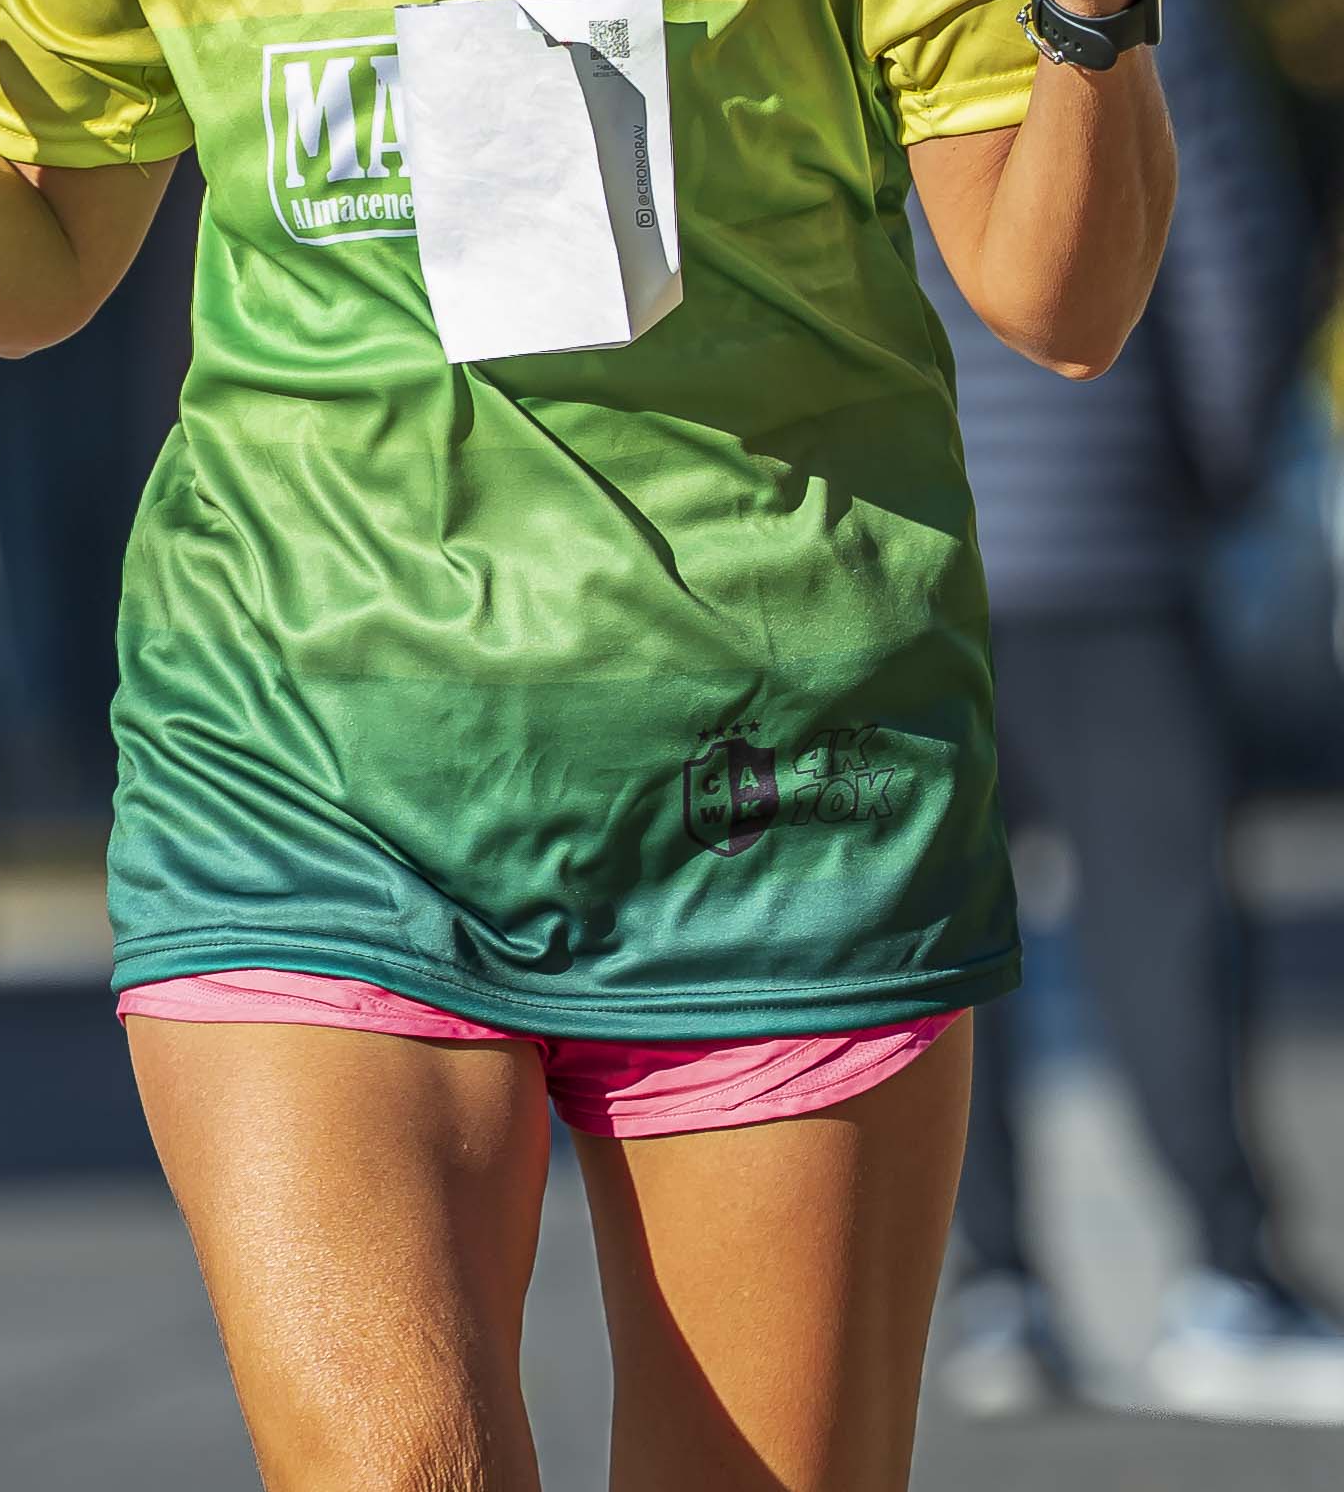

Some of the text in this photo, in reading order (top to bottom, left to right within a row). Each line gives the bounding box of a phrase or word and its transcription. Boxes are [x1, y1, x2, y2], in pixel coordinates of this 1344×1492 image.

[634, 124, 650, 206] @CRONORAV
[793, 724, 878, 779] 4K
[791, 767, 895, 826] 10K
